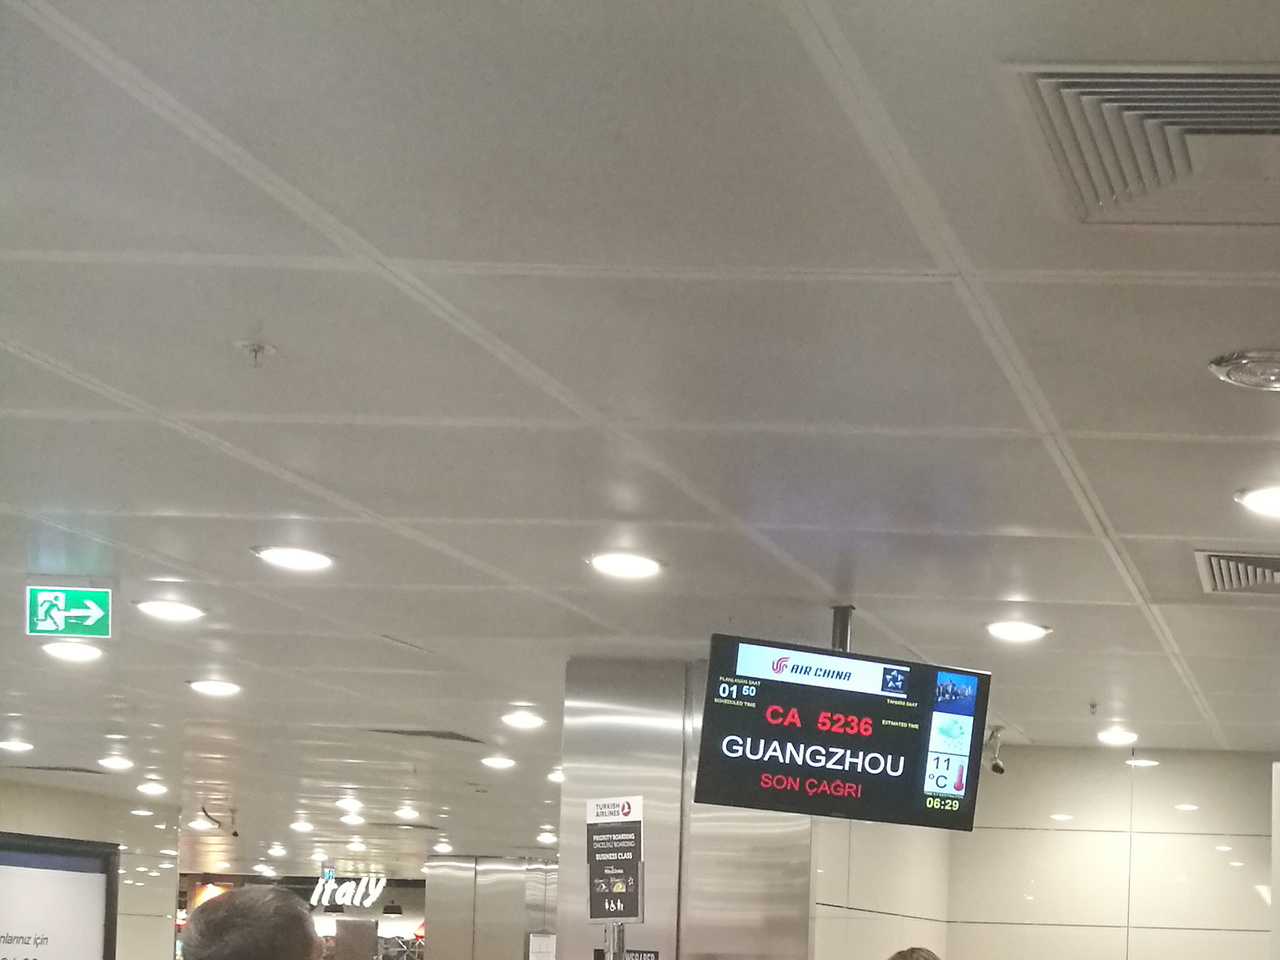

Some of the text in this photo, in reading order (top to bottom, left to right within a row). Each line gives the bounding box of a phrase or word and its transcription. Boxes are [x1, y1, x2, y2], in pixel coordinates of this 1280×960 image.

[790, 664, 852, 681] AIR CHINA
[719, 682, 757, 699] 01 50
[765, 705, 873, 736] CA 5236
[882, 719, 908, 728] ESTIMATED
[721, 735, 906, 776] GUANGZHOU
[933, 756, 951, 771] 11
[760, 774, 863, 798] SON ÇAĞRI
[596, 802, 621, 811] TURKISH
[926, 797, 960, 811] 06:29
[596, 809, 621, 818] AIRLINES
[595, 852, 633, 861] BUSINESS CLASS
[33, 933, 48, 948] için
